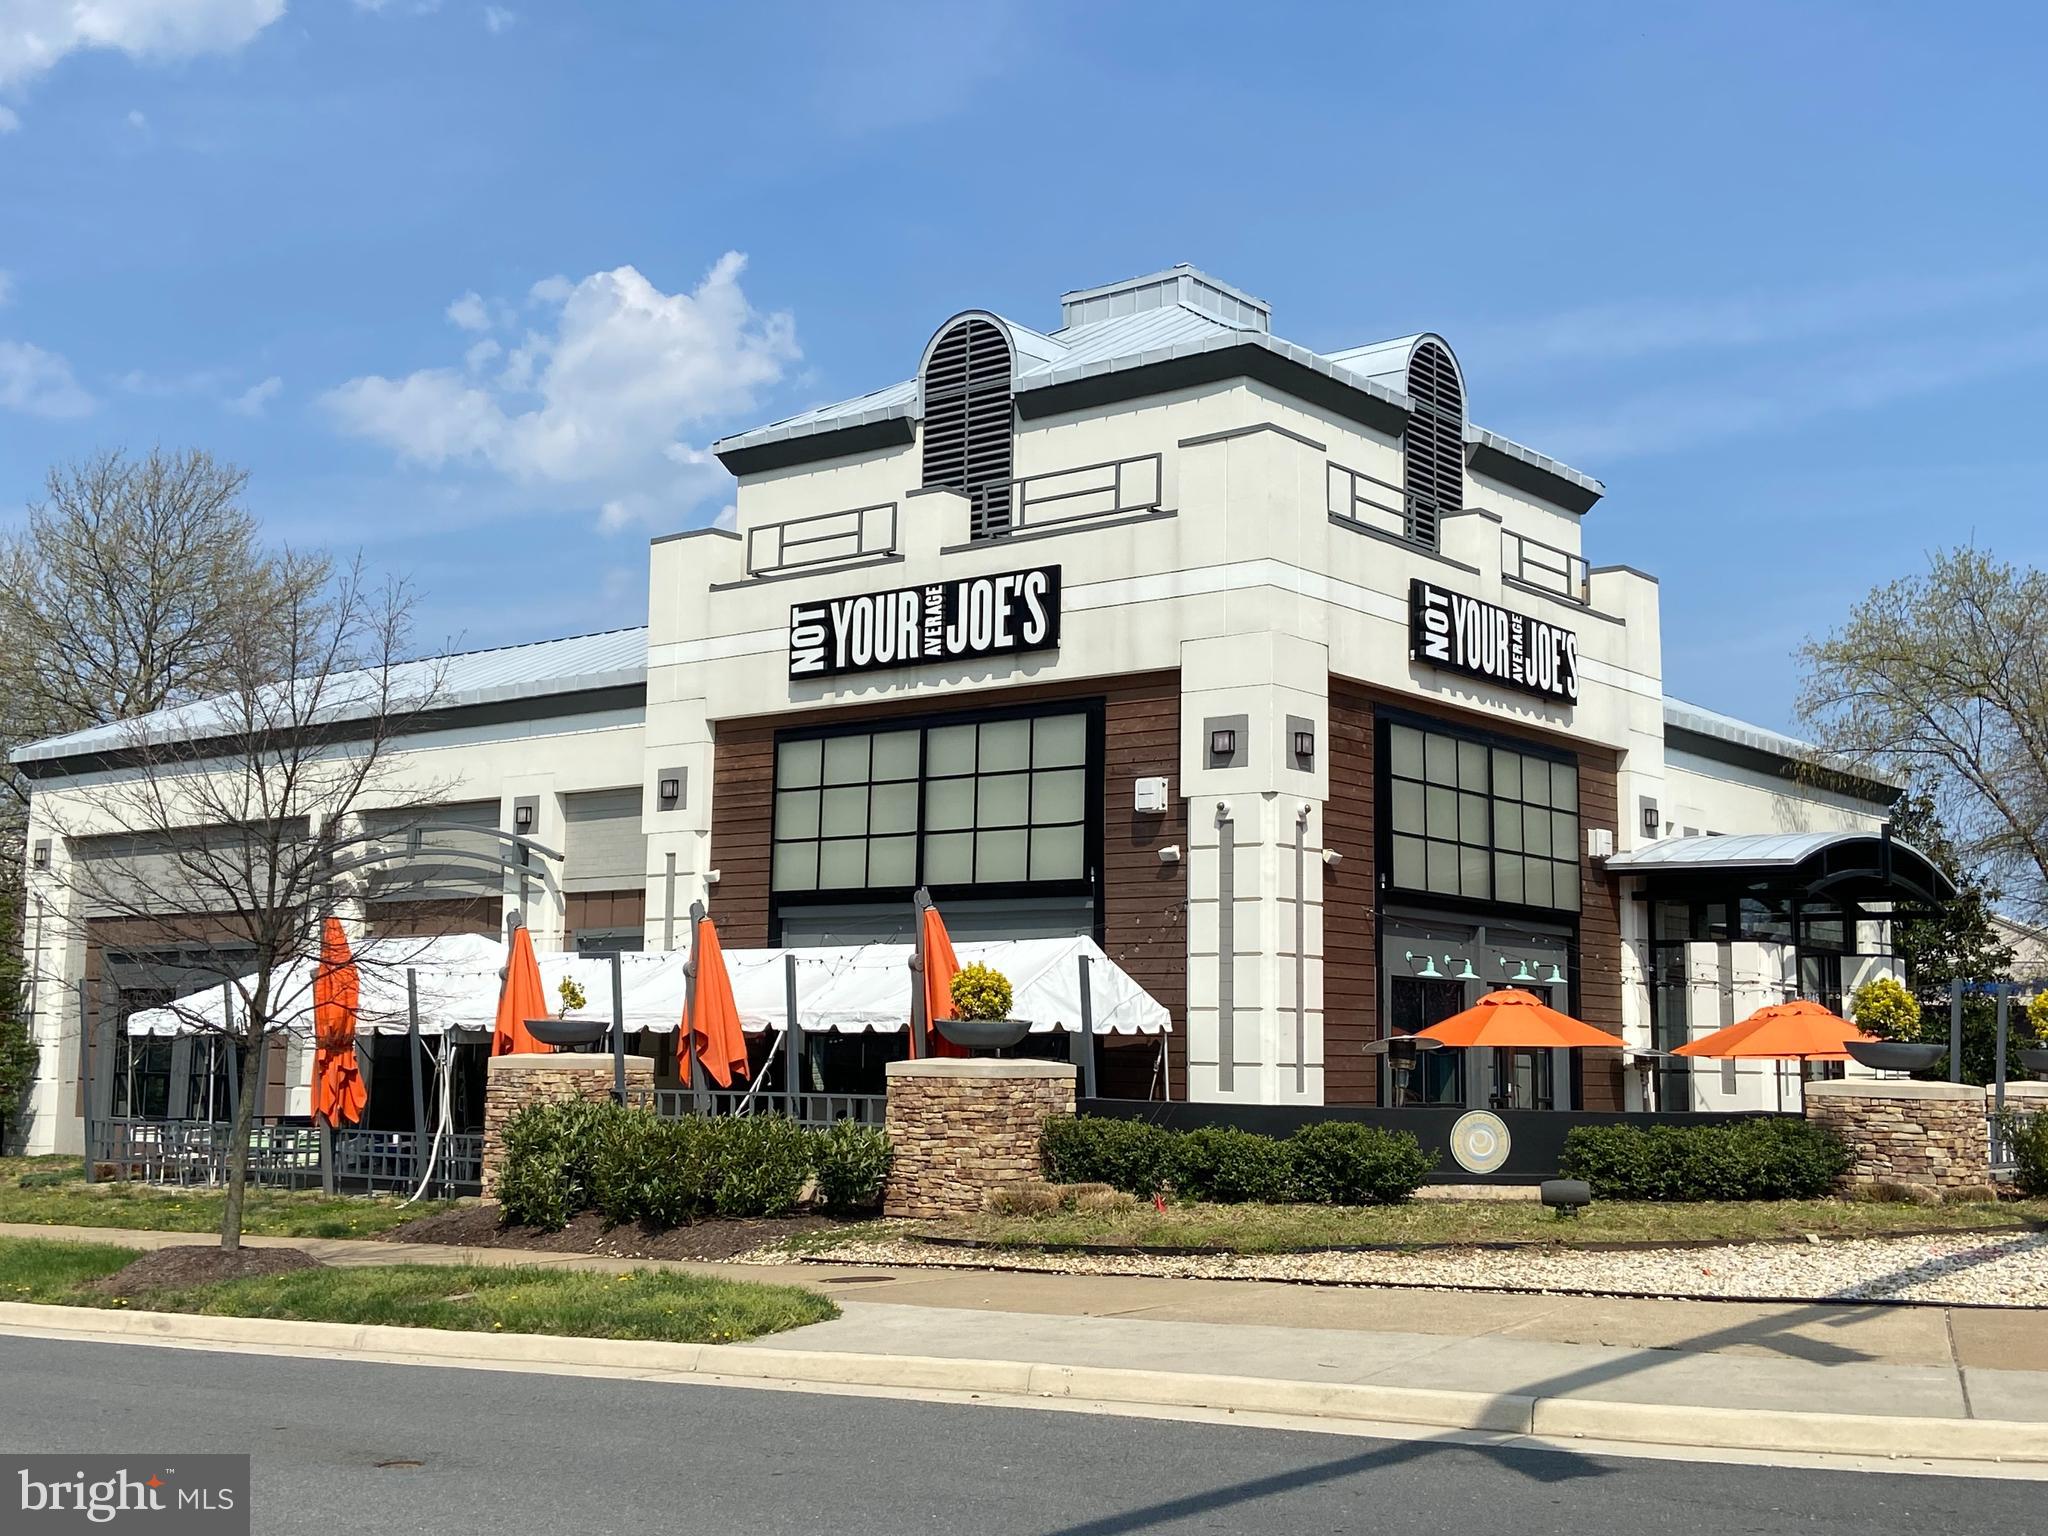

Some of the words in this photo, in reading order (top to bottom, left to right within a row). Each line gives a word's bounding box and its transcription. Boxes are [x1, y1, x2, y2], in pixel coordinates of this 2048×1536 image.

[791, 607, 826, 673] NOT
[830, 590, 921, 668] YOUR
[923, 584, 944, 656] AVERAGE
[946, 570, 1048, 654] JOE'S
[1425, 585, 1449, 661] NOT
[1451, 594, 1510, 679] YOUR
[1512, 613, 1524, 683] AVERAGE
[1525, 621, 1579, 698] JOE'S
